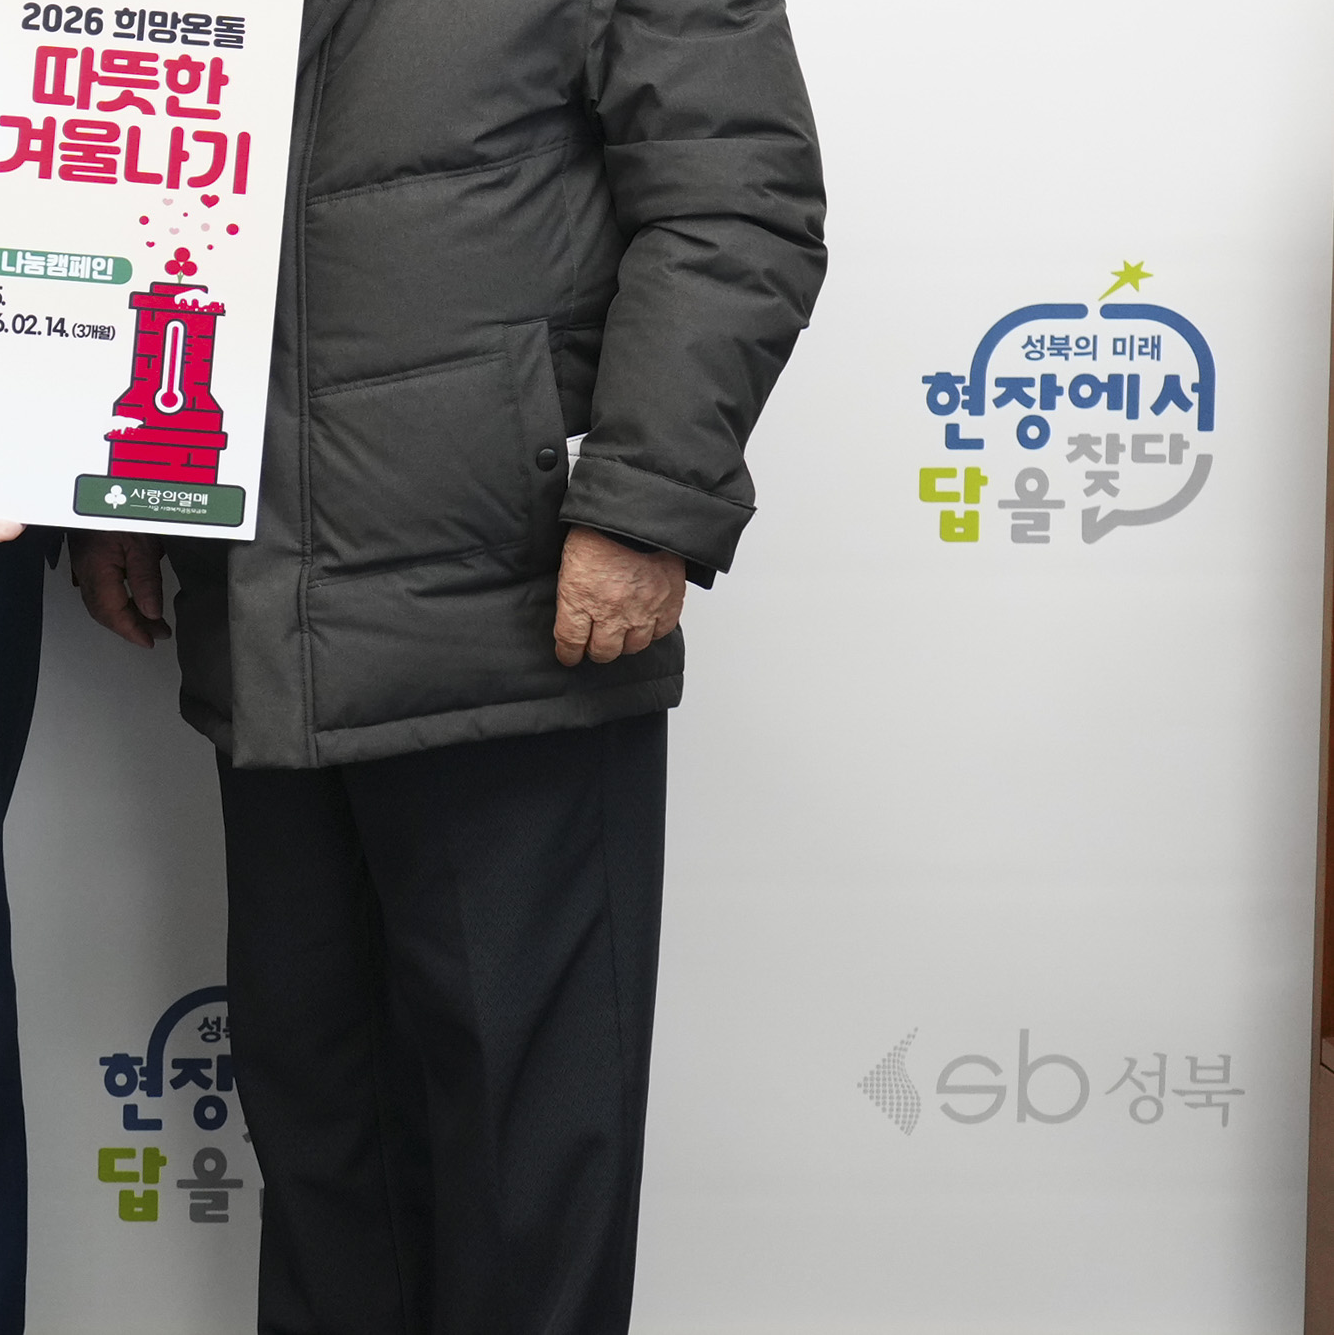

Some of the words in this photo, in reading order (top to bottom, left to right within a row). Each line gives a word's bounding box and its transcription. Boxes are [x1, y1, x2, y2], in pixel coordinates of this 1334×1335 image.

[21, 2, 104, 36] 2026
[113, 7, 246, 50] 희망온돌
[32, 45, 229, 120] 따뜻한
[1, 250, 114, 281] 나눔캠페인
[71, 322, 116, 341] (3개월)
[1021, 335, 1097, 361] 성북의
[1113, 335, 1162, 361] 미래
[922, 372, 1216, 450] 현장에서
[130, 488, 209, 507] 사랑의열매
[99, 1053, 234, 1131] 현장
[936, 1028, 1090, 1125] sb
[1105, 1052, 1246, 1128] 성북
